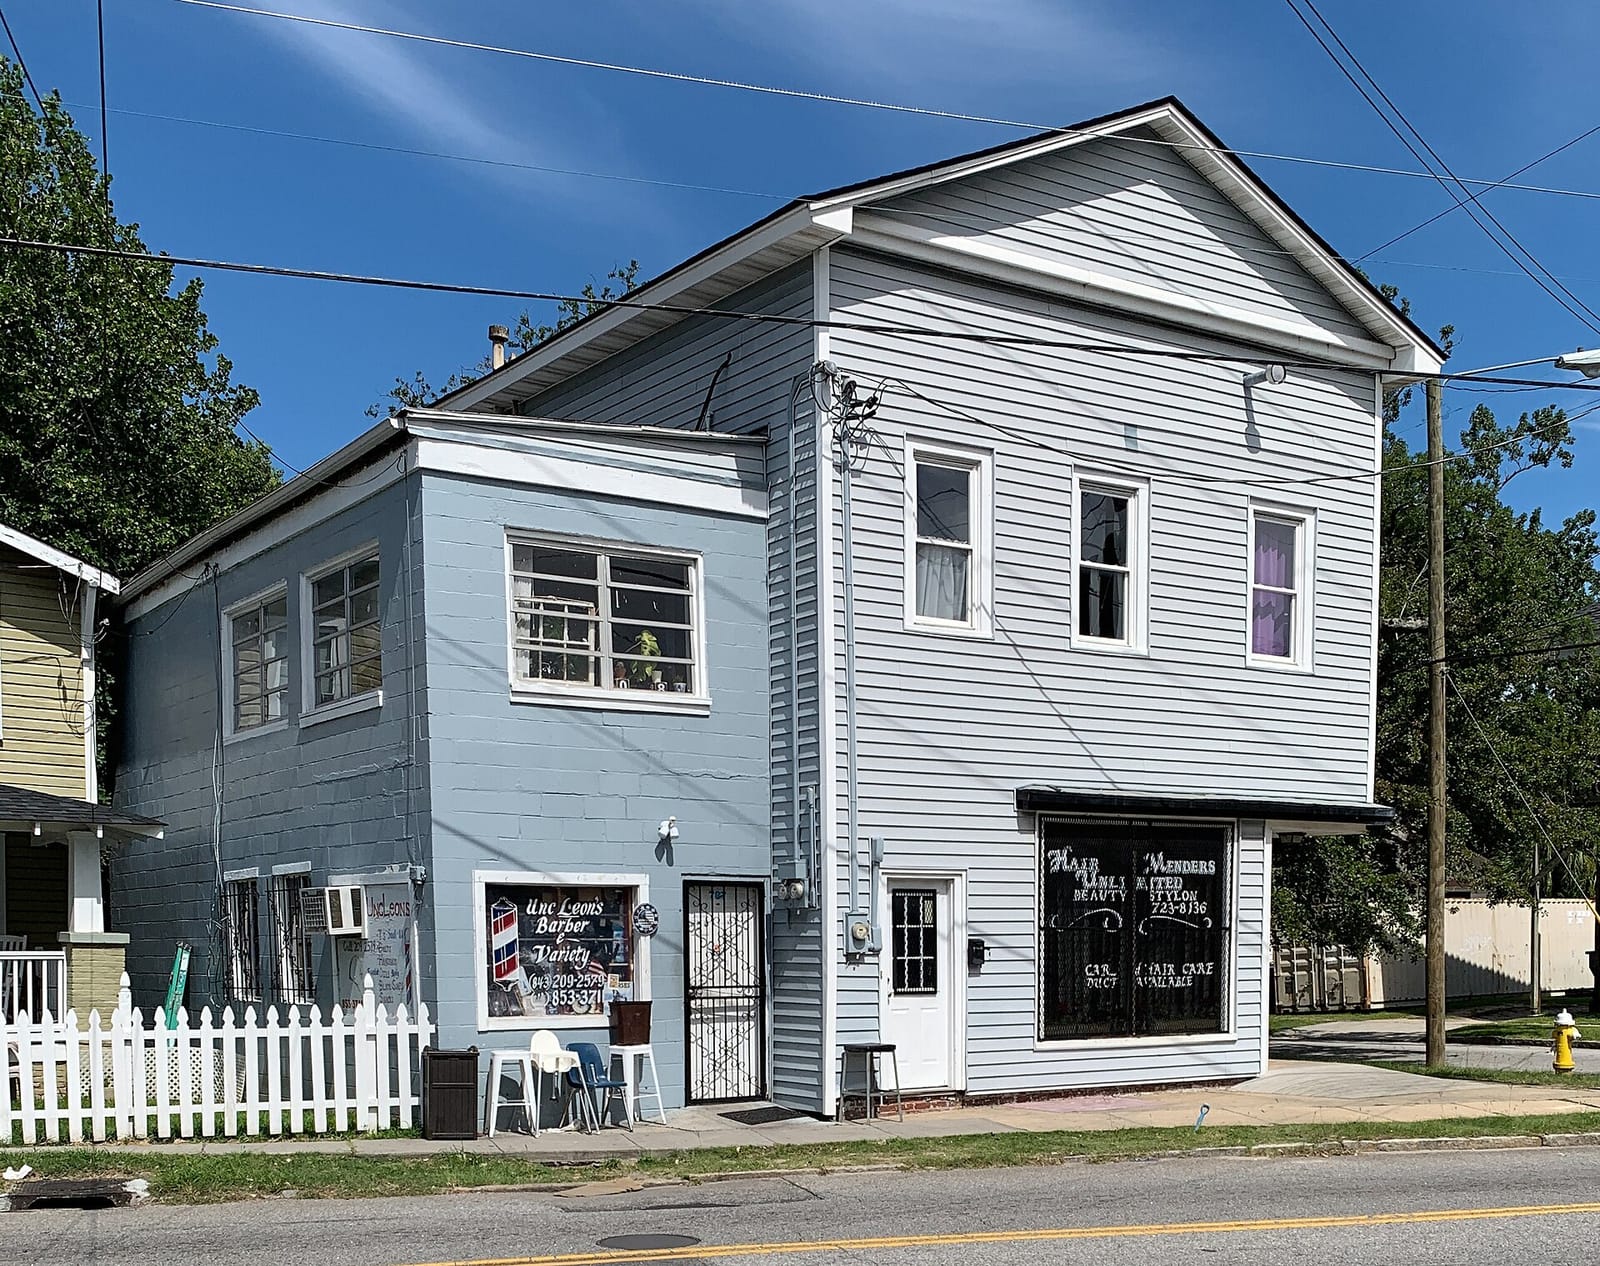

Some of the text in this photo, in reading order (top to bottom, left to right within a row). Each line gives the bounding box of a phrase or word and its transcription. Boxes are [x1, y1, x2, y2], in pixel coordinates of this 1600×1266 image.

[1073, 889, 1128, 902] BEAUTY
[526, 896, 604, 917] Unc Leon's
[1152, 901, 1208, 915] 723-8136
[535, 916, 590, 934] Barber
[532, 945, 590, 970] Variety
[1182, 962, 1215, 976] CARE
[552, 974, 604, 989] 209-2579
